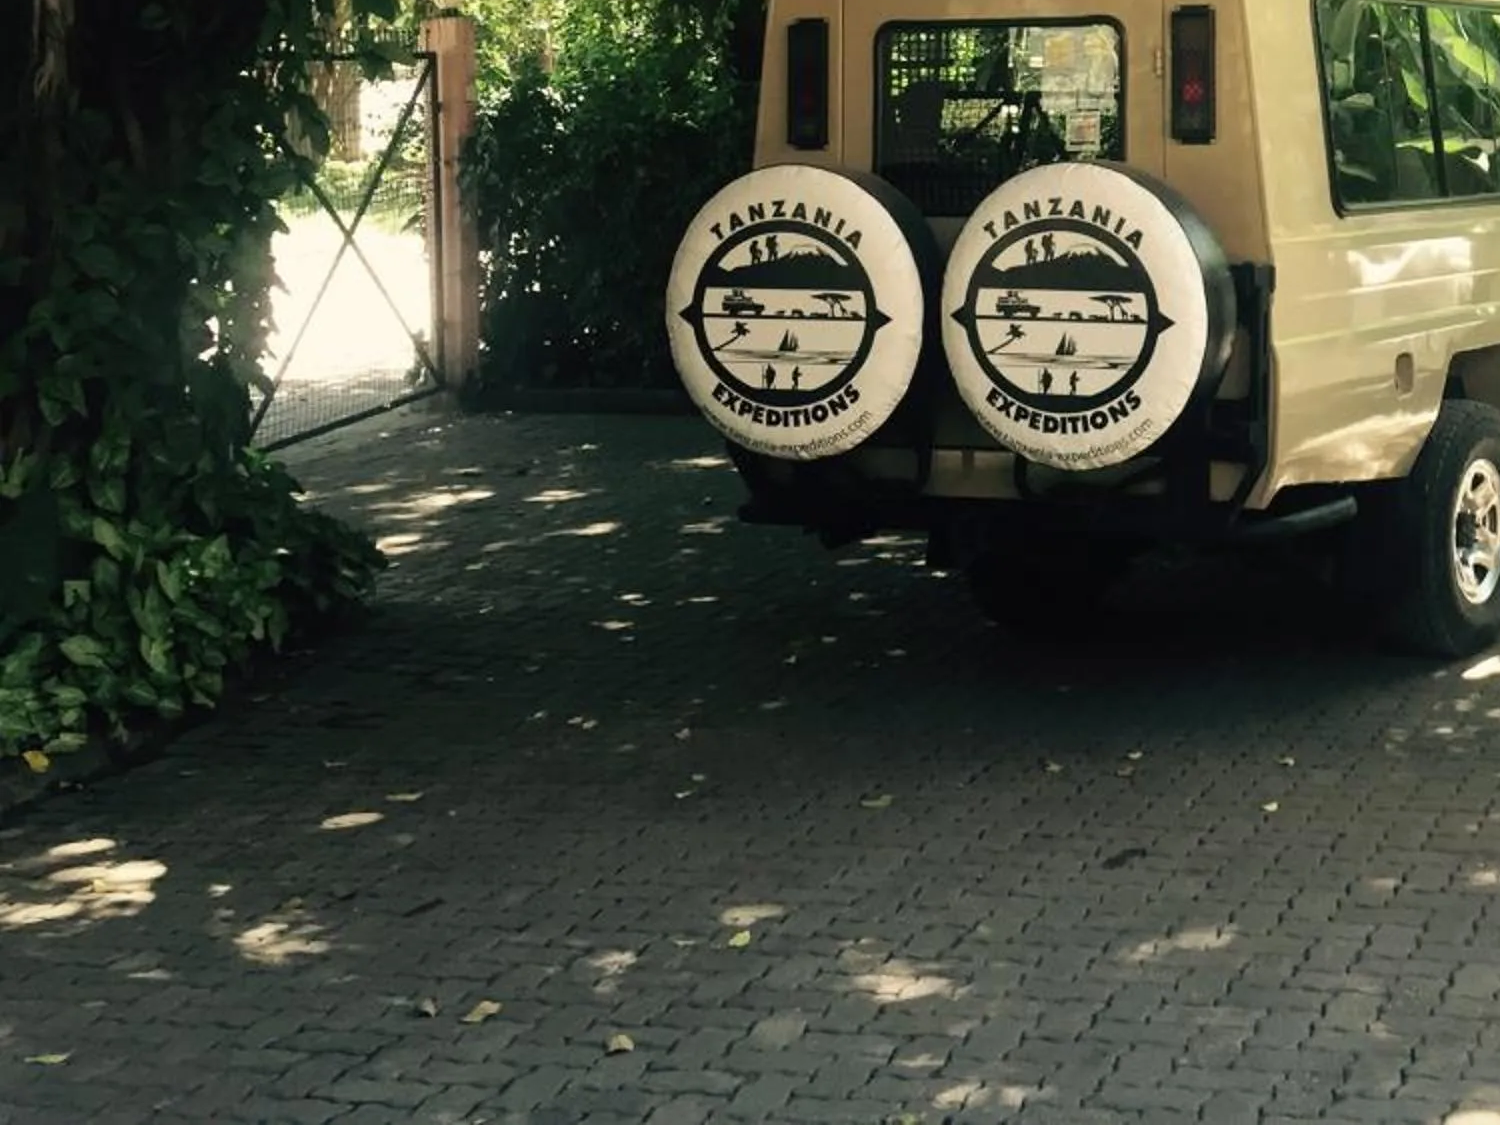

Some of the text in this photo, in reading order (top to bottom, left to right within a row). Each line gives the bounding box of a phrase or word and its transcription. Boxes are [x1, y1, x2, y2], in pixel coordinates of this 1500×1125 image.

[709, 199, 863, 250] TANZANIA
[982, 196, 1144, 251] TANZANIA
[711, 382, 861, 428] EXPEDITIONS
[985, 388, 1142, 435] EXPEDITIONS
